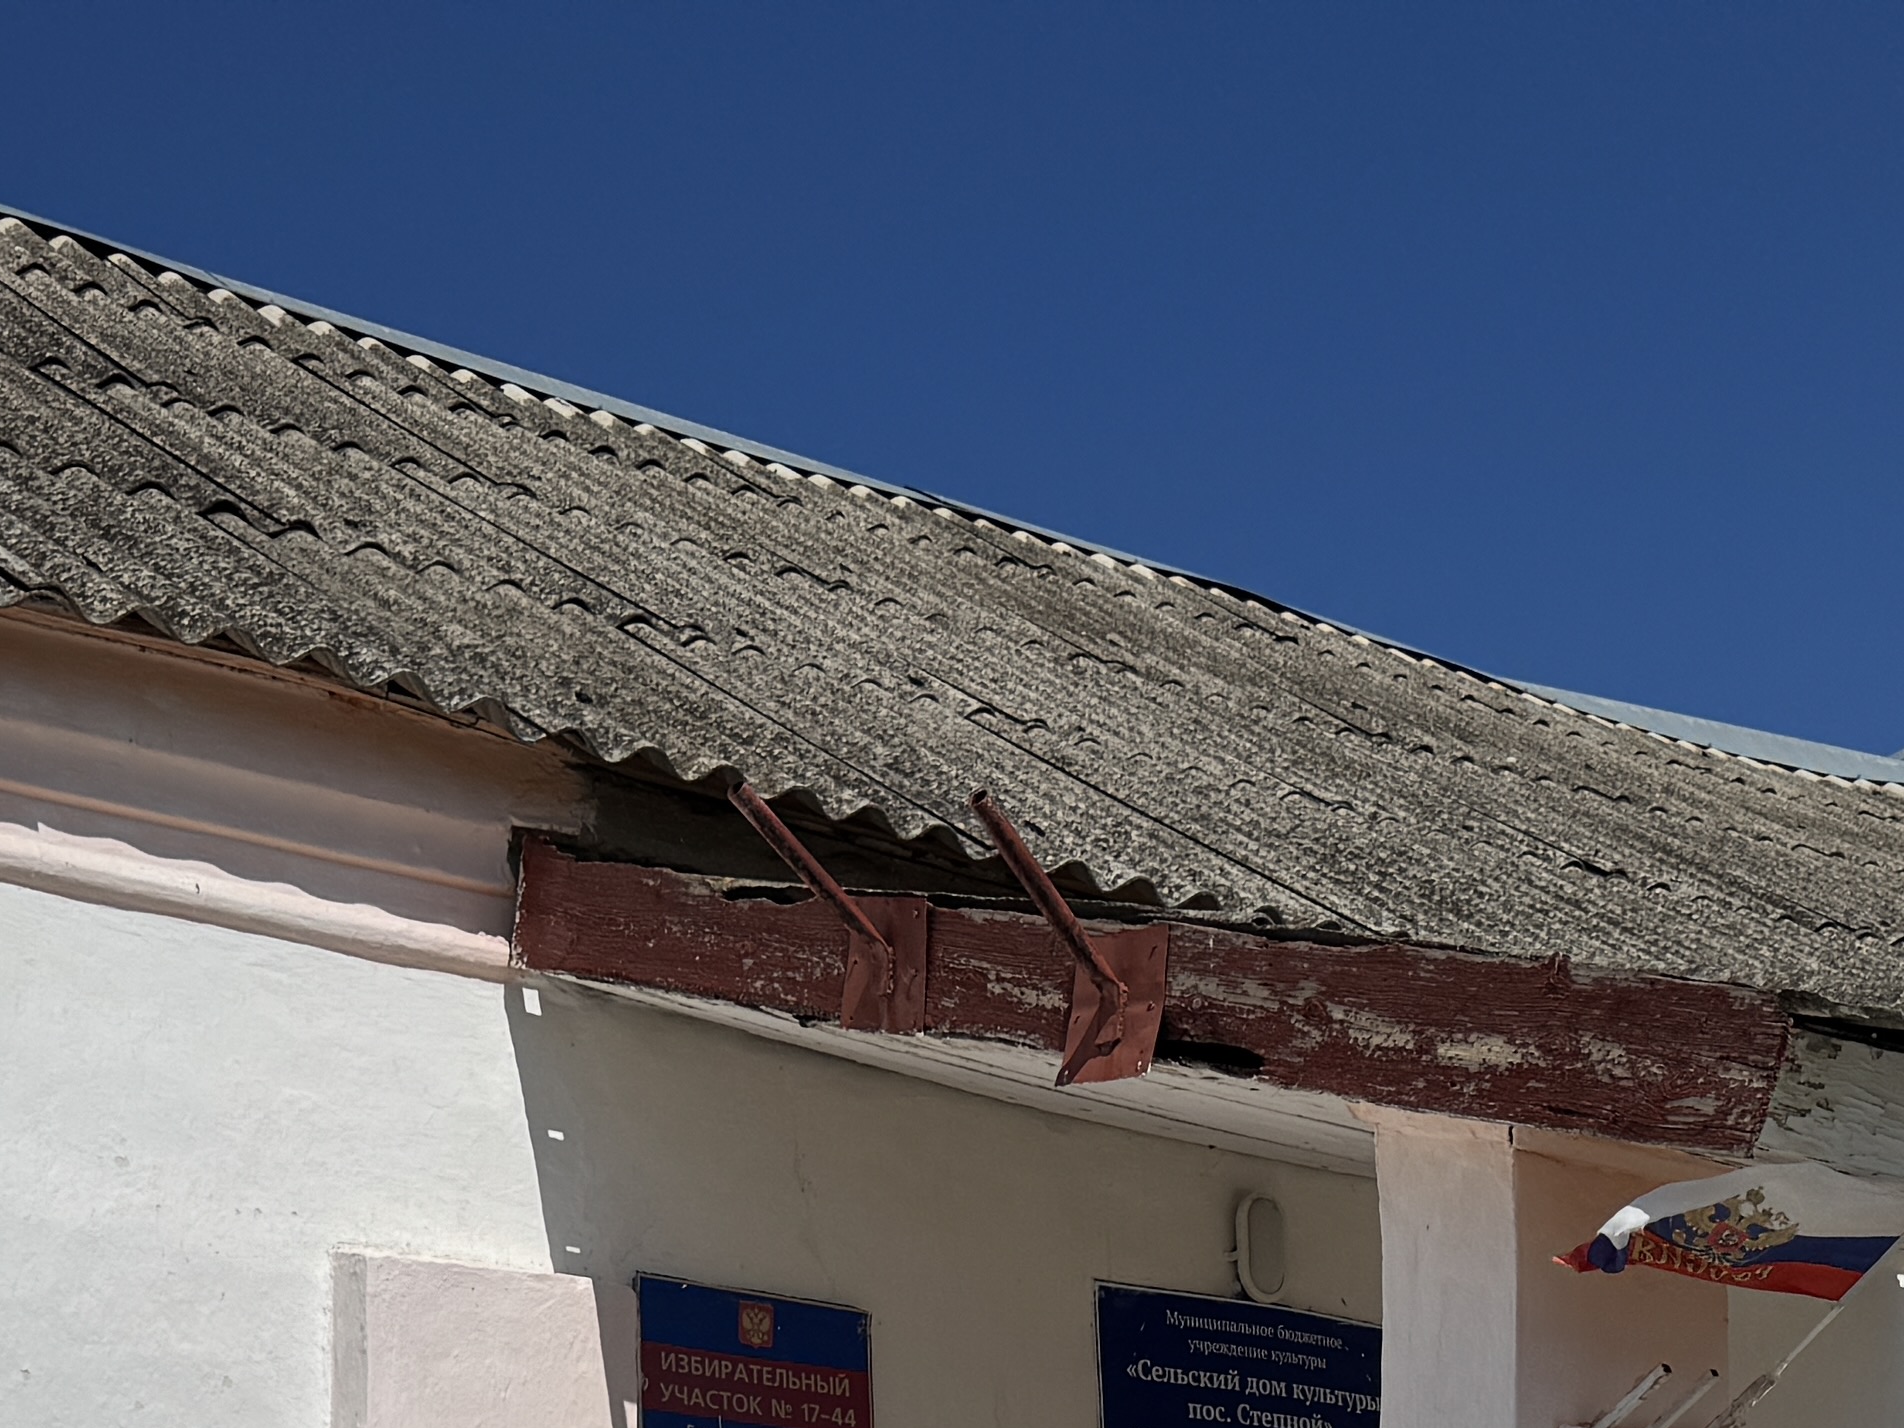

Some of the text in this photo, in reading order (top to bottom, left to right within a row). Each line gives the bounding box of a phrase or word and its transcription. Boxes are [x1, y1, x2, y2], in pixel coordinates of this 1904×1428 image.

[1166, 1309, 1343, 1349] Муниципальное бюджетное
[661, 1351, 851, 1397] ИЗБИРАТЕЛЬНЫЙ
[1188, 1339, 1327, 1370] учреждение культуры
[1126, 1358, 1240, 1391] «Сельский
[1246, 1376, 1287, 1398] дом
[660, 1382, 857, 1428] УЧАСТОК № 17-44
[1187, 1402, 1231, 1423] пос.
